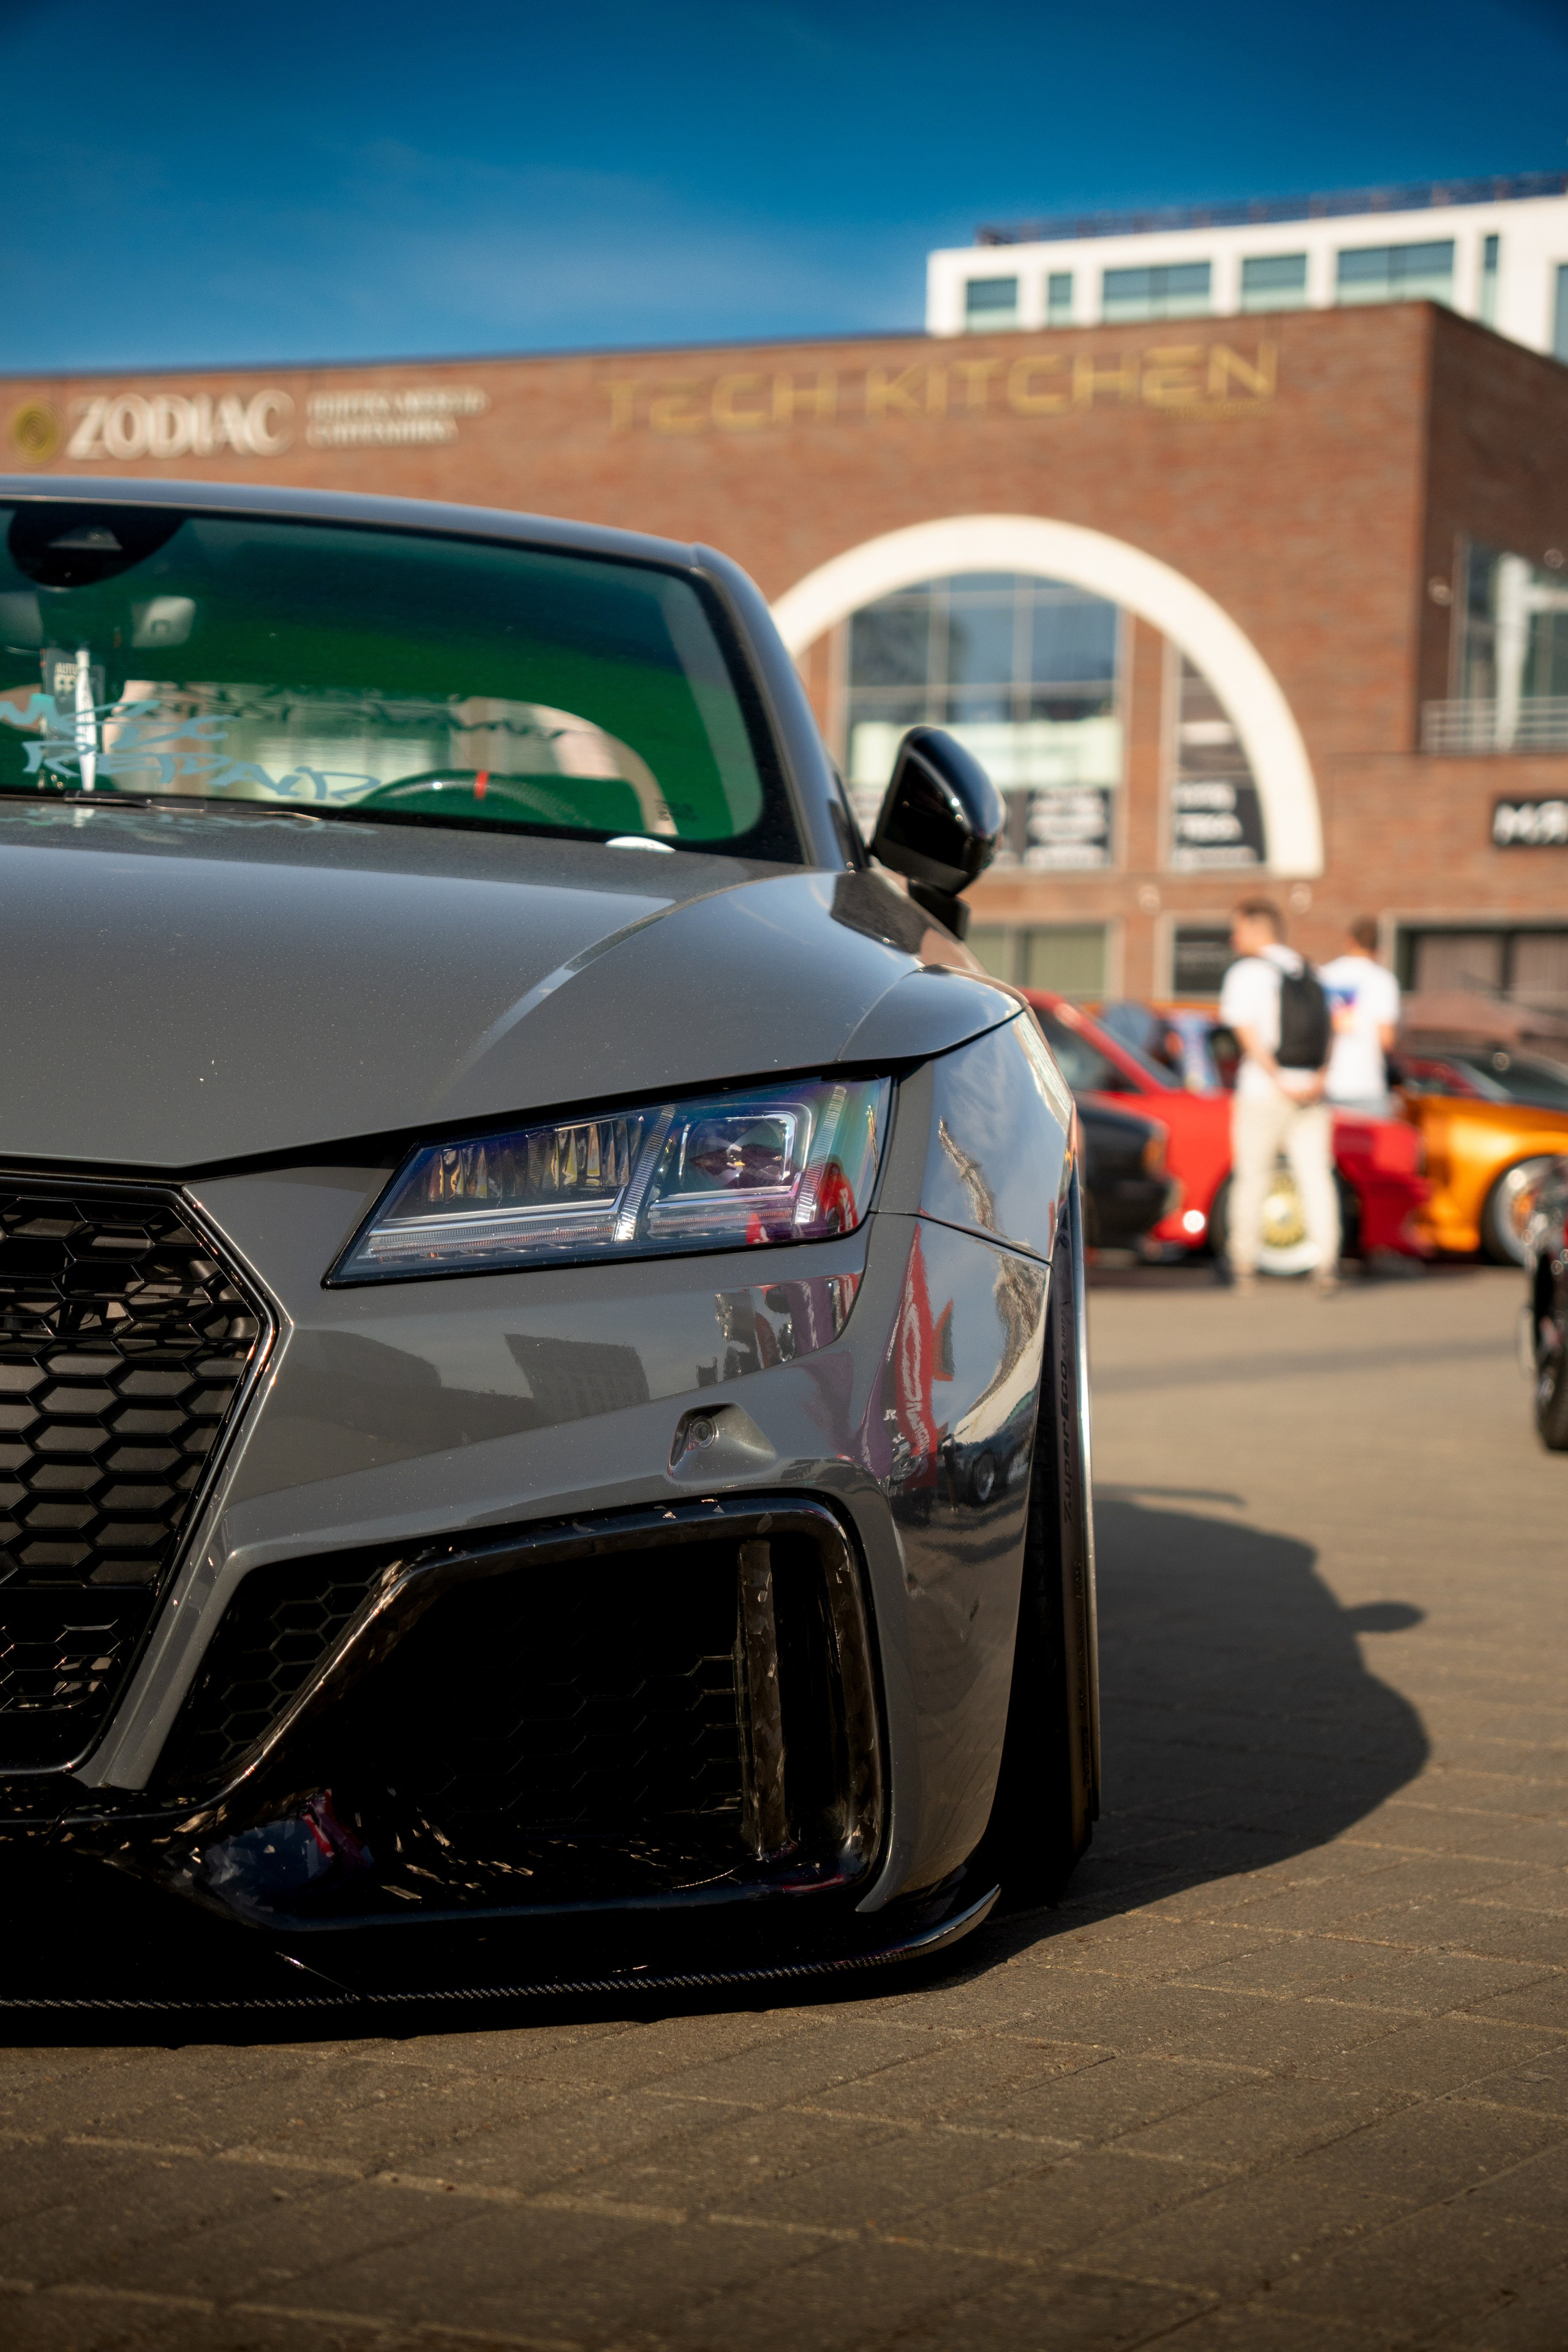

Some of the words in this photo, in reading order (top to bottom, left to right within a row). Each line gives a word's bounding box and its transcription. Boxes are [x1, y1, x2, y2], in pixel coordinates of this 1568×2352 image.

[67, 390, 295, 459] ZODIAC
[599, 371, 839, 432] TECH
[864, 342, 1278, 420] KITCHEN
